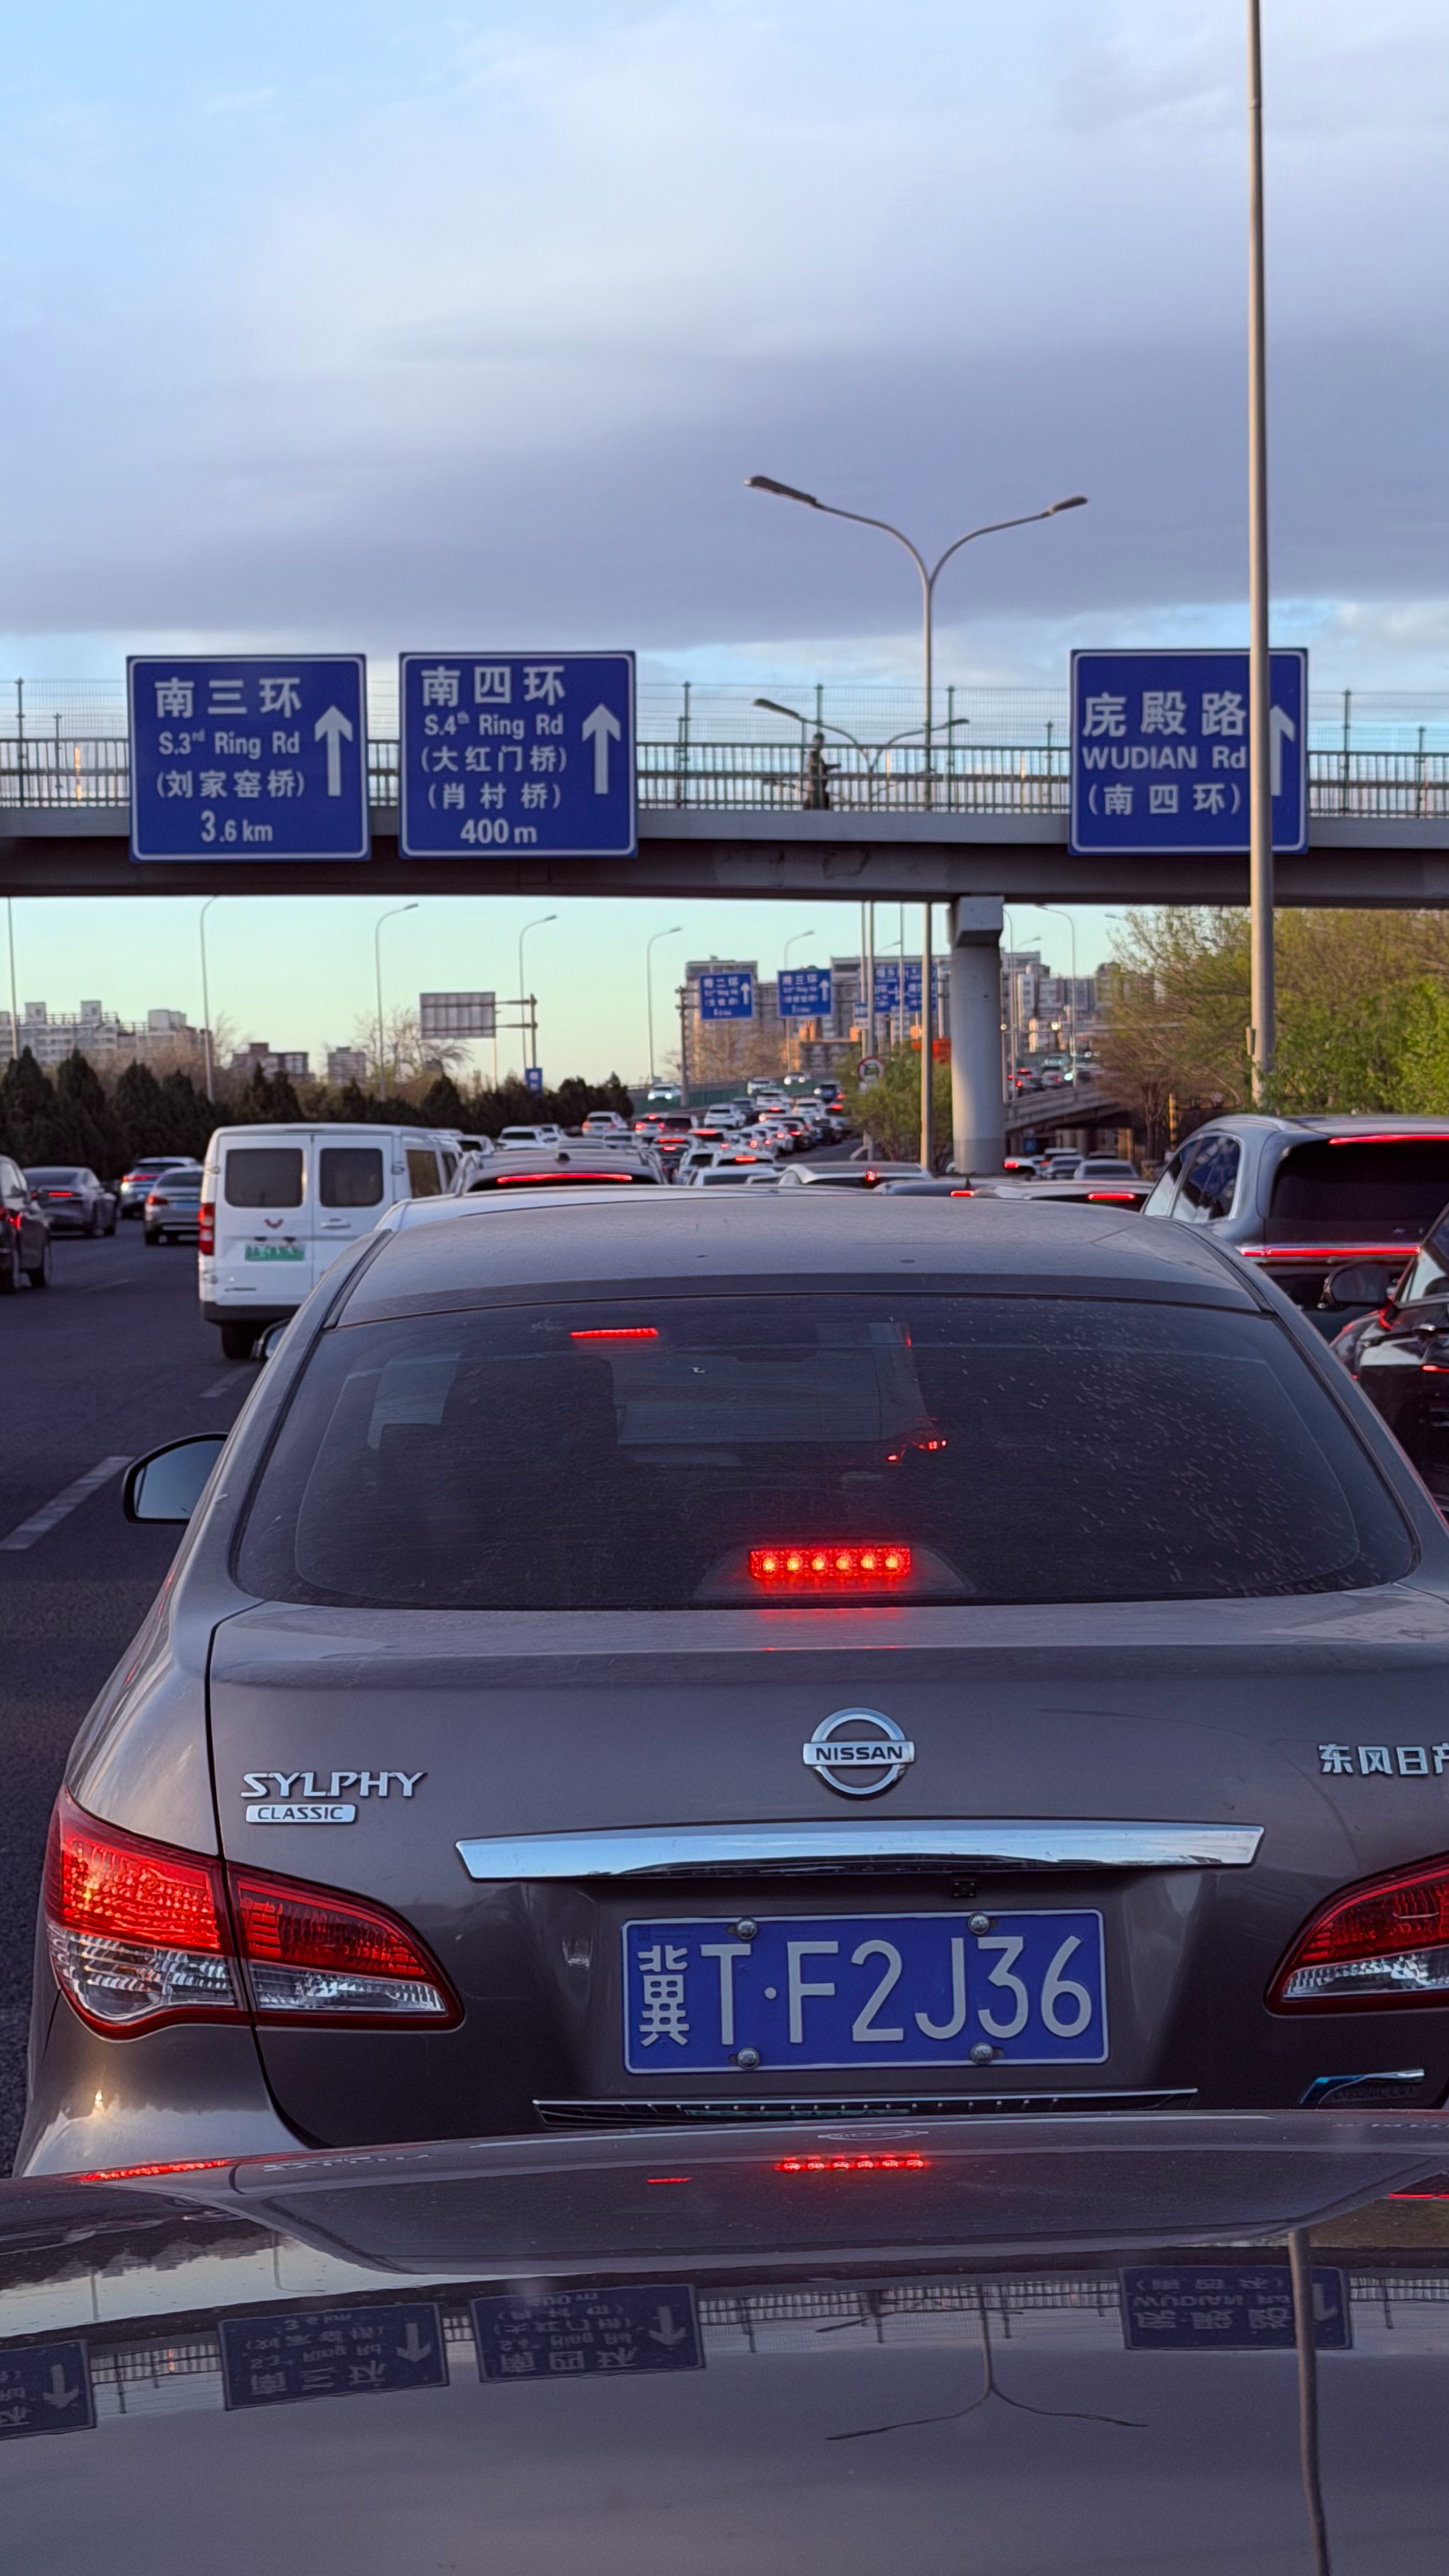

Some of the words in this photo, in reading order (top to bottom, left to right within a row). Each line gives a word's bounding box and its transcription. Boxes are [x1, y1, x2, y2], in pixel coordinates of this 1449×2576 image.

[154, 677, 302, 718] 南三环
[420, 666, 566, 707] 南四环
[479, 714, 525, 739] Ring
[535, 714, 564, 735] Rd
[1082, 691, 1247, 737] 庑殿路
[215, 731, 261, 760] Ring
[272, 731, 300, 755] Rd
[420, 745, 567, 772] (大红门桥)
[1082, 746, 1198, 770] WUDIAN
[1212, 746, 1246, 769] Rd
[156, 770, 305, 799] (刘家窑桥)
[1088, 783, 1241, 816] (南四环)
[815, 1745, 903, 1761] NISSAN
[240, 1771, 427, 1797] SYLPHY
[257, 1806, 344, 1820] CLASSIC
